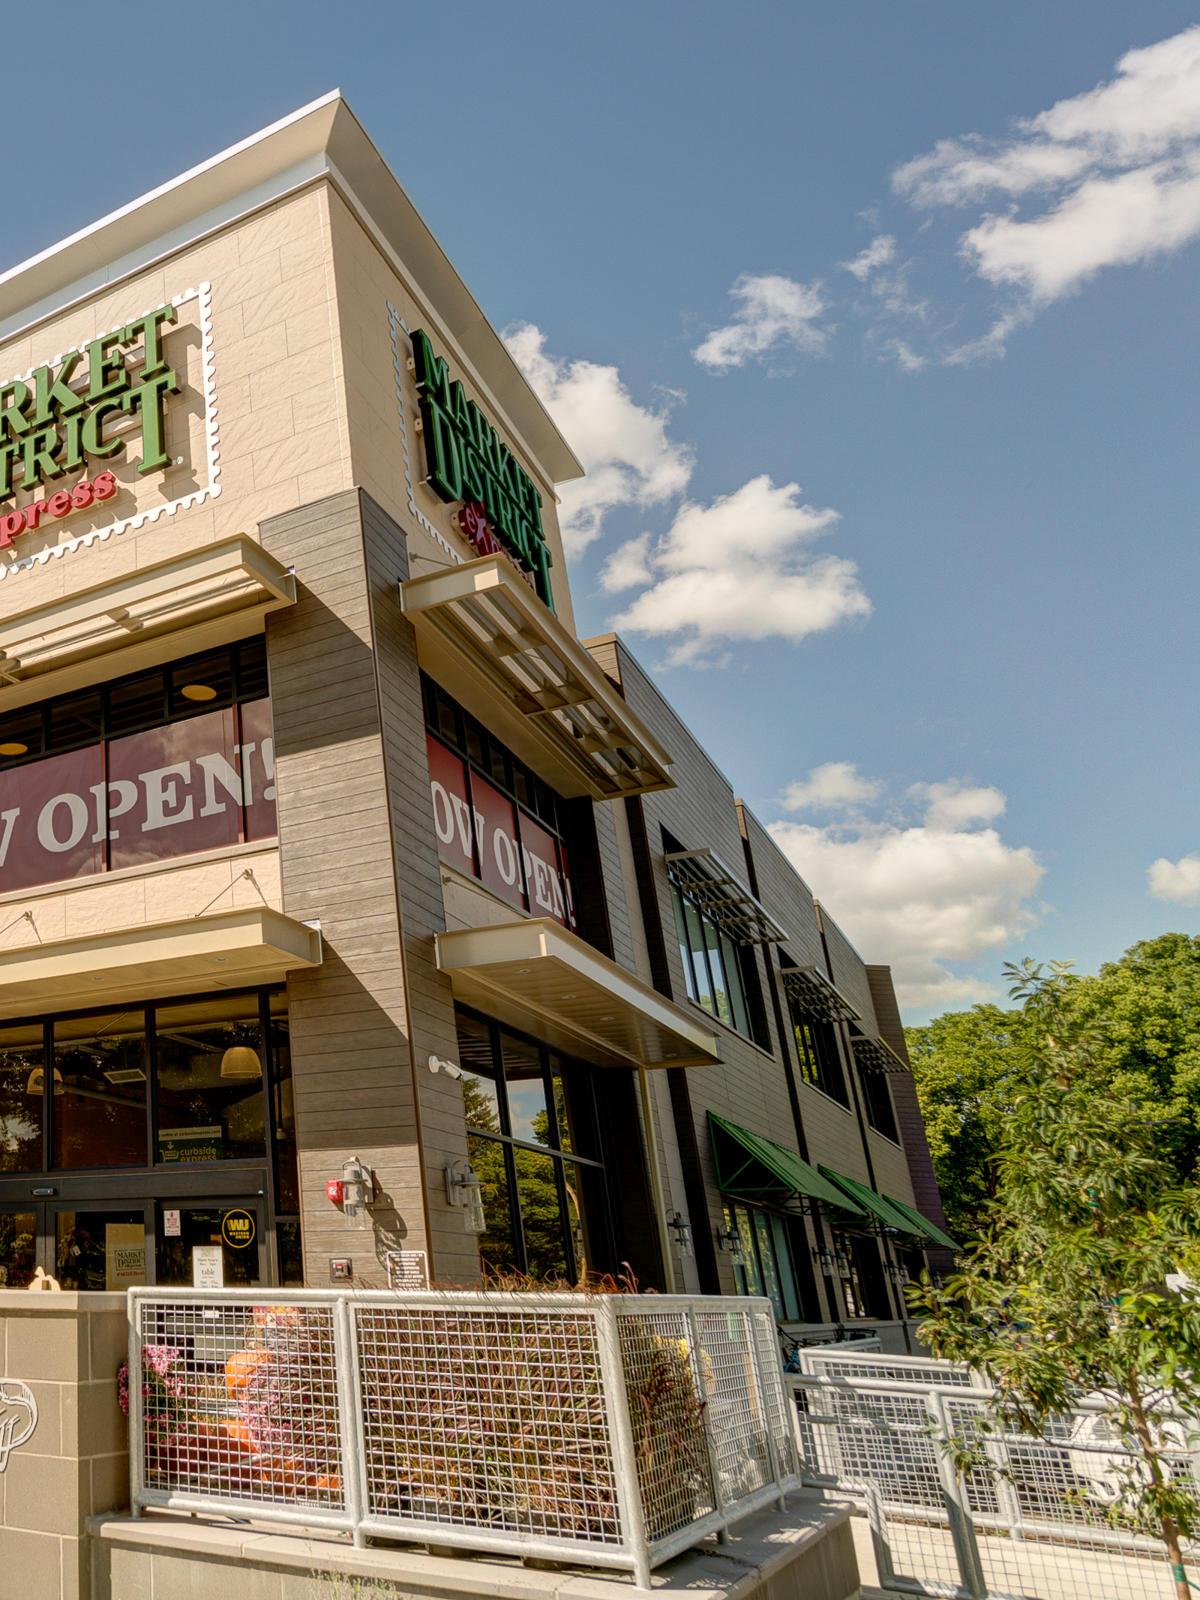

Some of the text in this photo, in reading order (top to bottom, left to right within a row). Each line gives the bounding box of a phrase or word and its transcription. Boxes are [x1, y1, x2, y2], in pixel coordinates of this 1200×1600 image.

[410, 328, 546, 541] MARKET
[37, 737, 276, 853] OPEN!
[180, 1146, 216, 1156] curbside
[226, 1218, 250, 1231] WU
